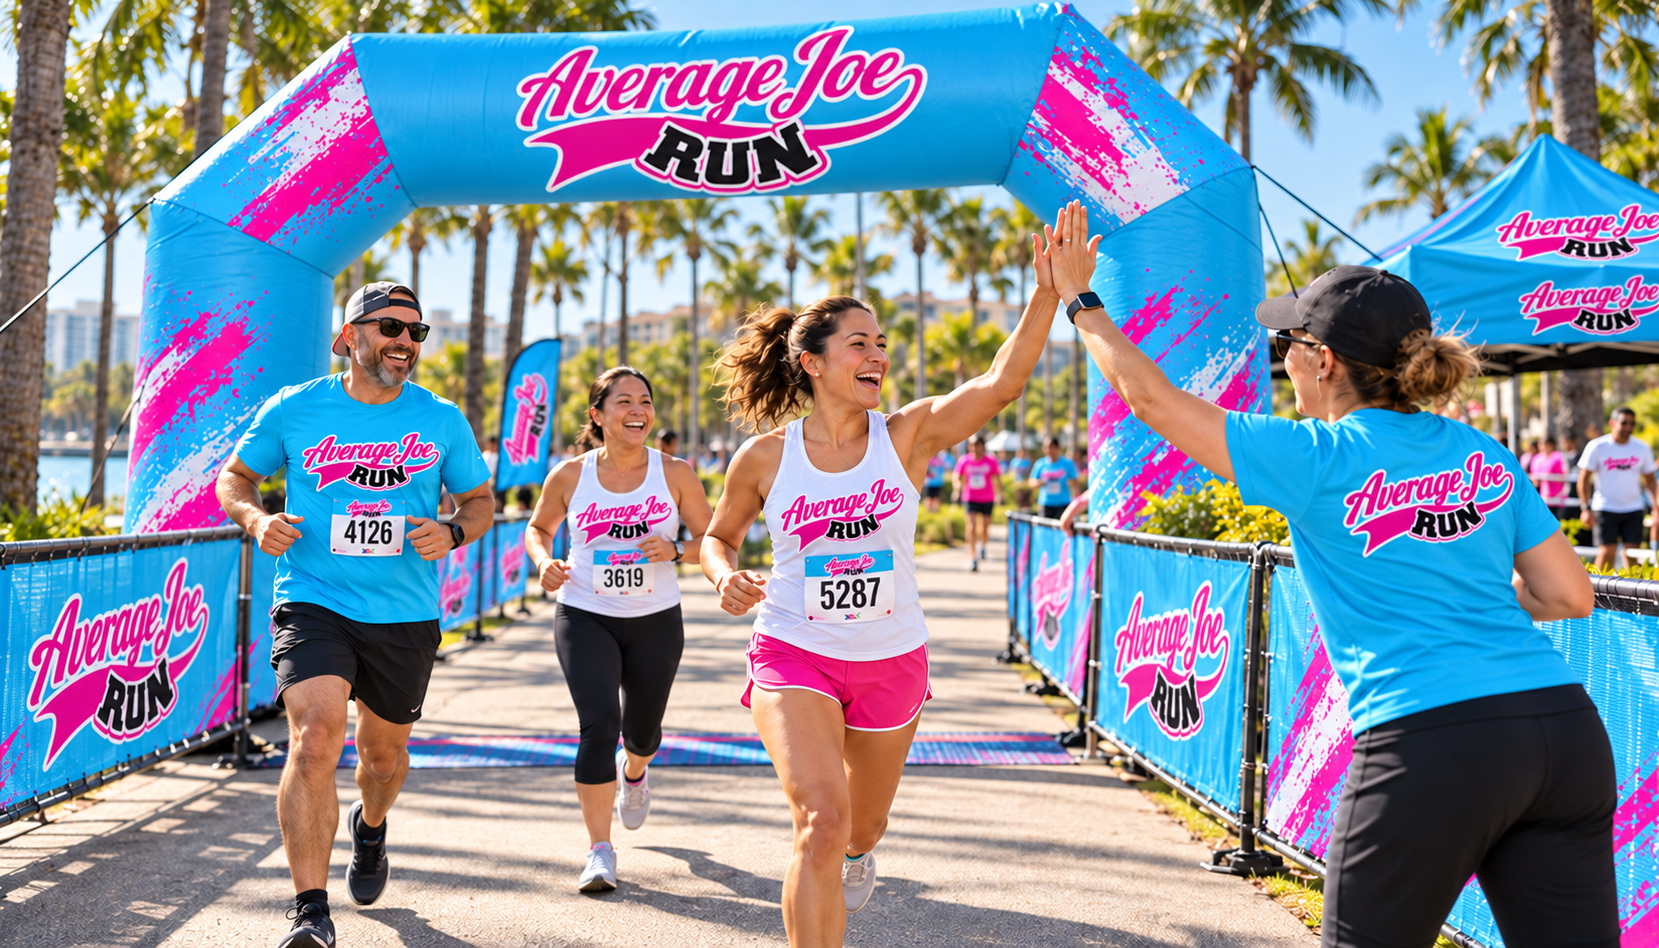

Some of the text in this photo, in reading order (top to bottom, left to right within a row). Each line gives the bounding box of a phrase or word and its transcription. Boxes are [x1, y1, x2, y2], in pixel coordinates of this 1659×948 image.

[518, 28, 902, 128] Average Joe
[644, 121, 819, 184] RUN
[1498, 205, 1659, 243] Average Joe
[1560, 237, 1634, 257] RUN
[1520, 275, 1659, 314] Average Joe
[1574, 308, 1636, 331] RUN
[303, 432, 434, 468] Average Joe
[348, 464, 407, 487] RUN
[1344, 452, 1504, 526] Average Joe
[576, 495, 668, 528] Average Joe
[781, 479, 900, 531] Average Joe
[1411, 501, 1482, 538] RUN
[344, 520, 392, 544] 4126
[607, 520, 649, 539] RUN
[826, 513, 879, 539] RUN
[603, 567, 643, 588] 3619
[820, 577, 881, 610] 5287
[30, 561, 203, 707] Average Joe
[1116, 585, 1223, 675] Average Joe
[97, 658, 174, 731] RUN
[1151, 671, 1200, 729] RUN
